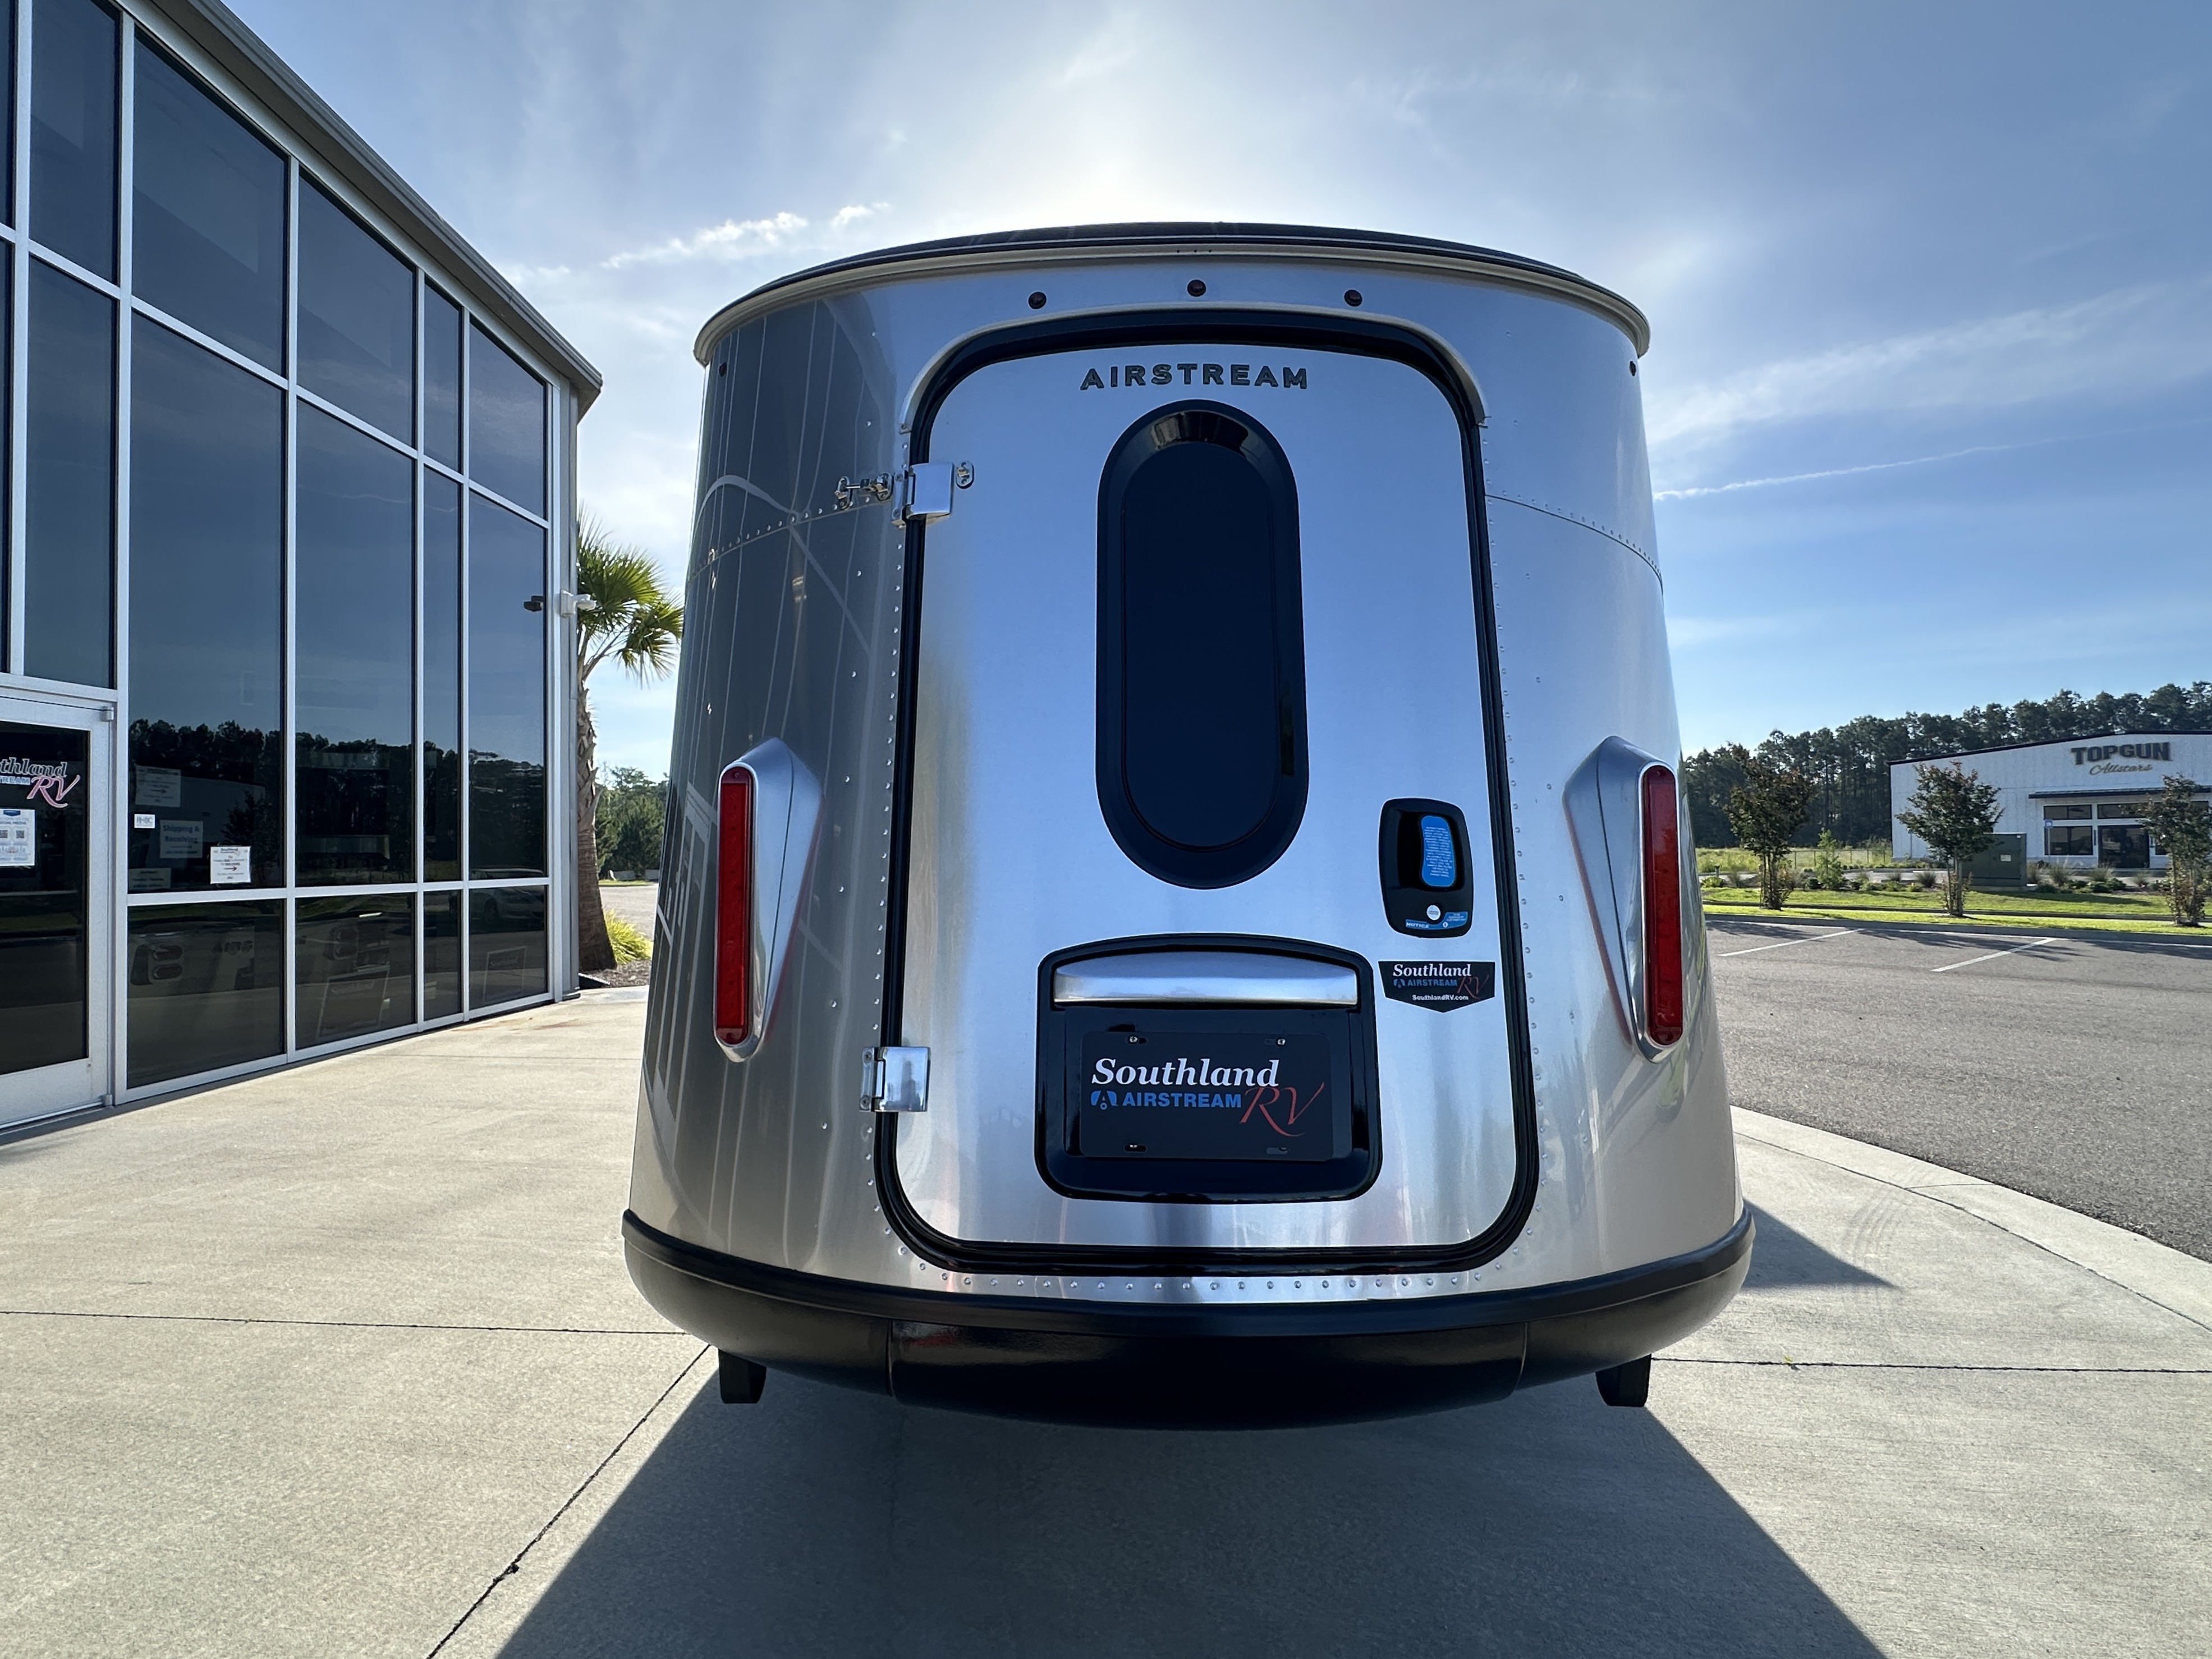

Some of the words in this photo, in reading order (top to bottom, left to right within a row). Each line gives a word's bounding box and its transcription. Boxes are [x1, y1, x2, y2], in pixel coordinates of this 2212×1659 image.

[1080, 363, 1307, 390] AIRSTREAM
[0, 757, 68, 778] thland
[0, 776, 30, 785] REAM
[26, 774, 81, 808] RV
[163, 825, 193, 834] Shipping
[1393, 963, 1472, 977] Southland
[1457, 974, 1489, 1000] RV
[1091, 1057, 1280, 1087] Southland
[1122, 1092, 1242, 1108] AIRSTREAM
[1239, 1082, 1325, 1137] RV
